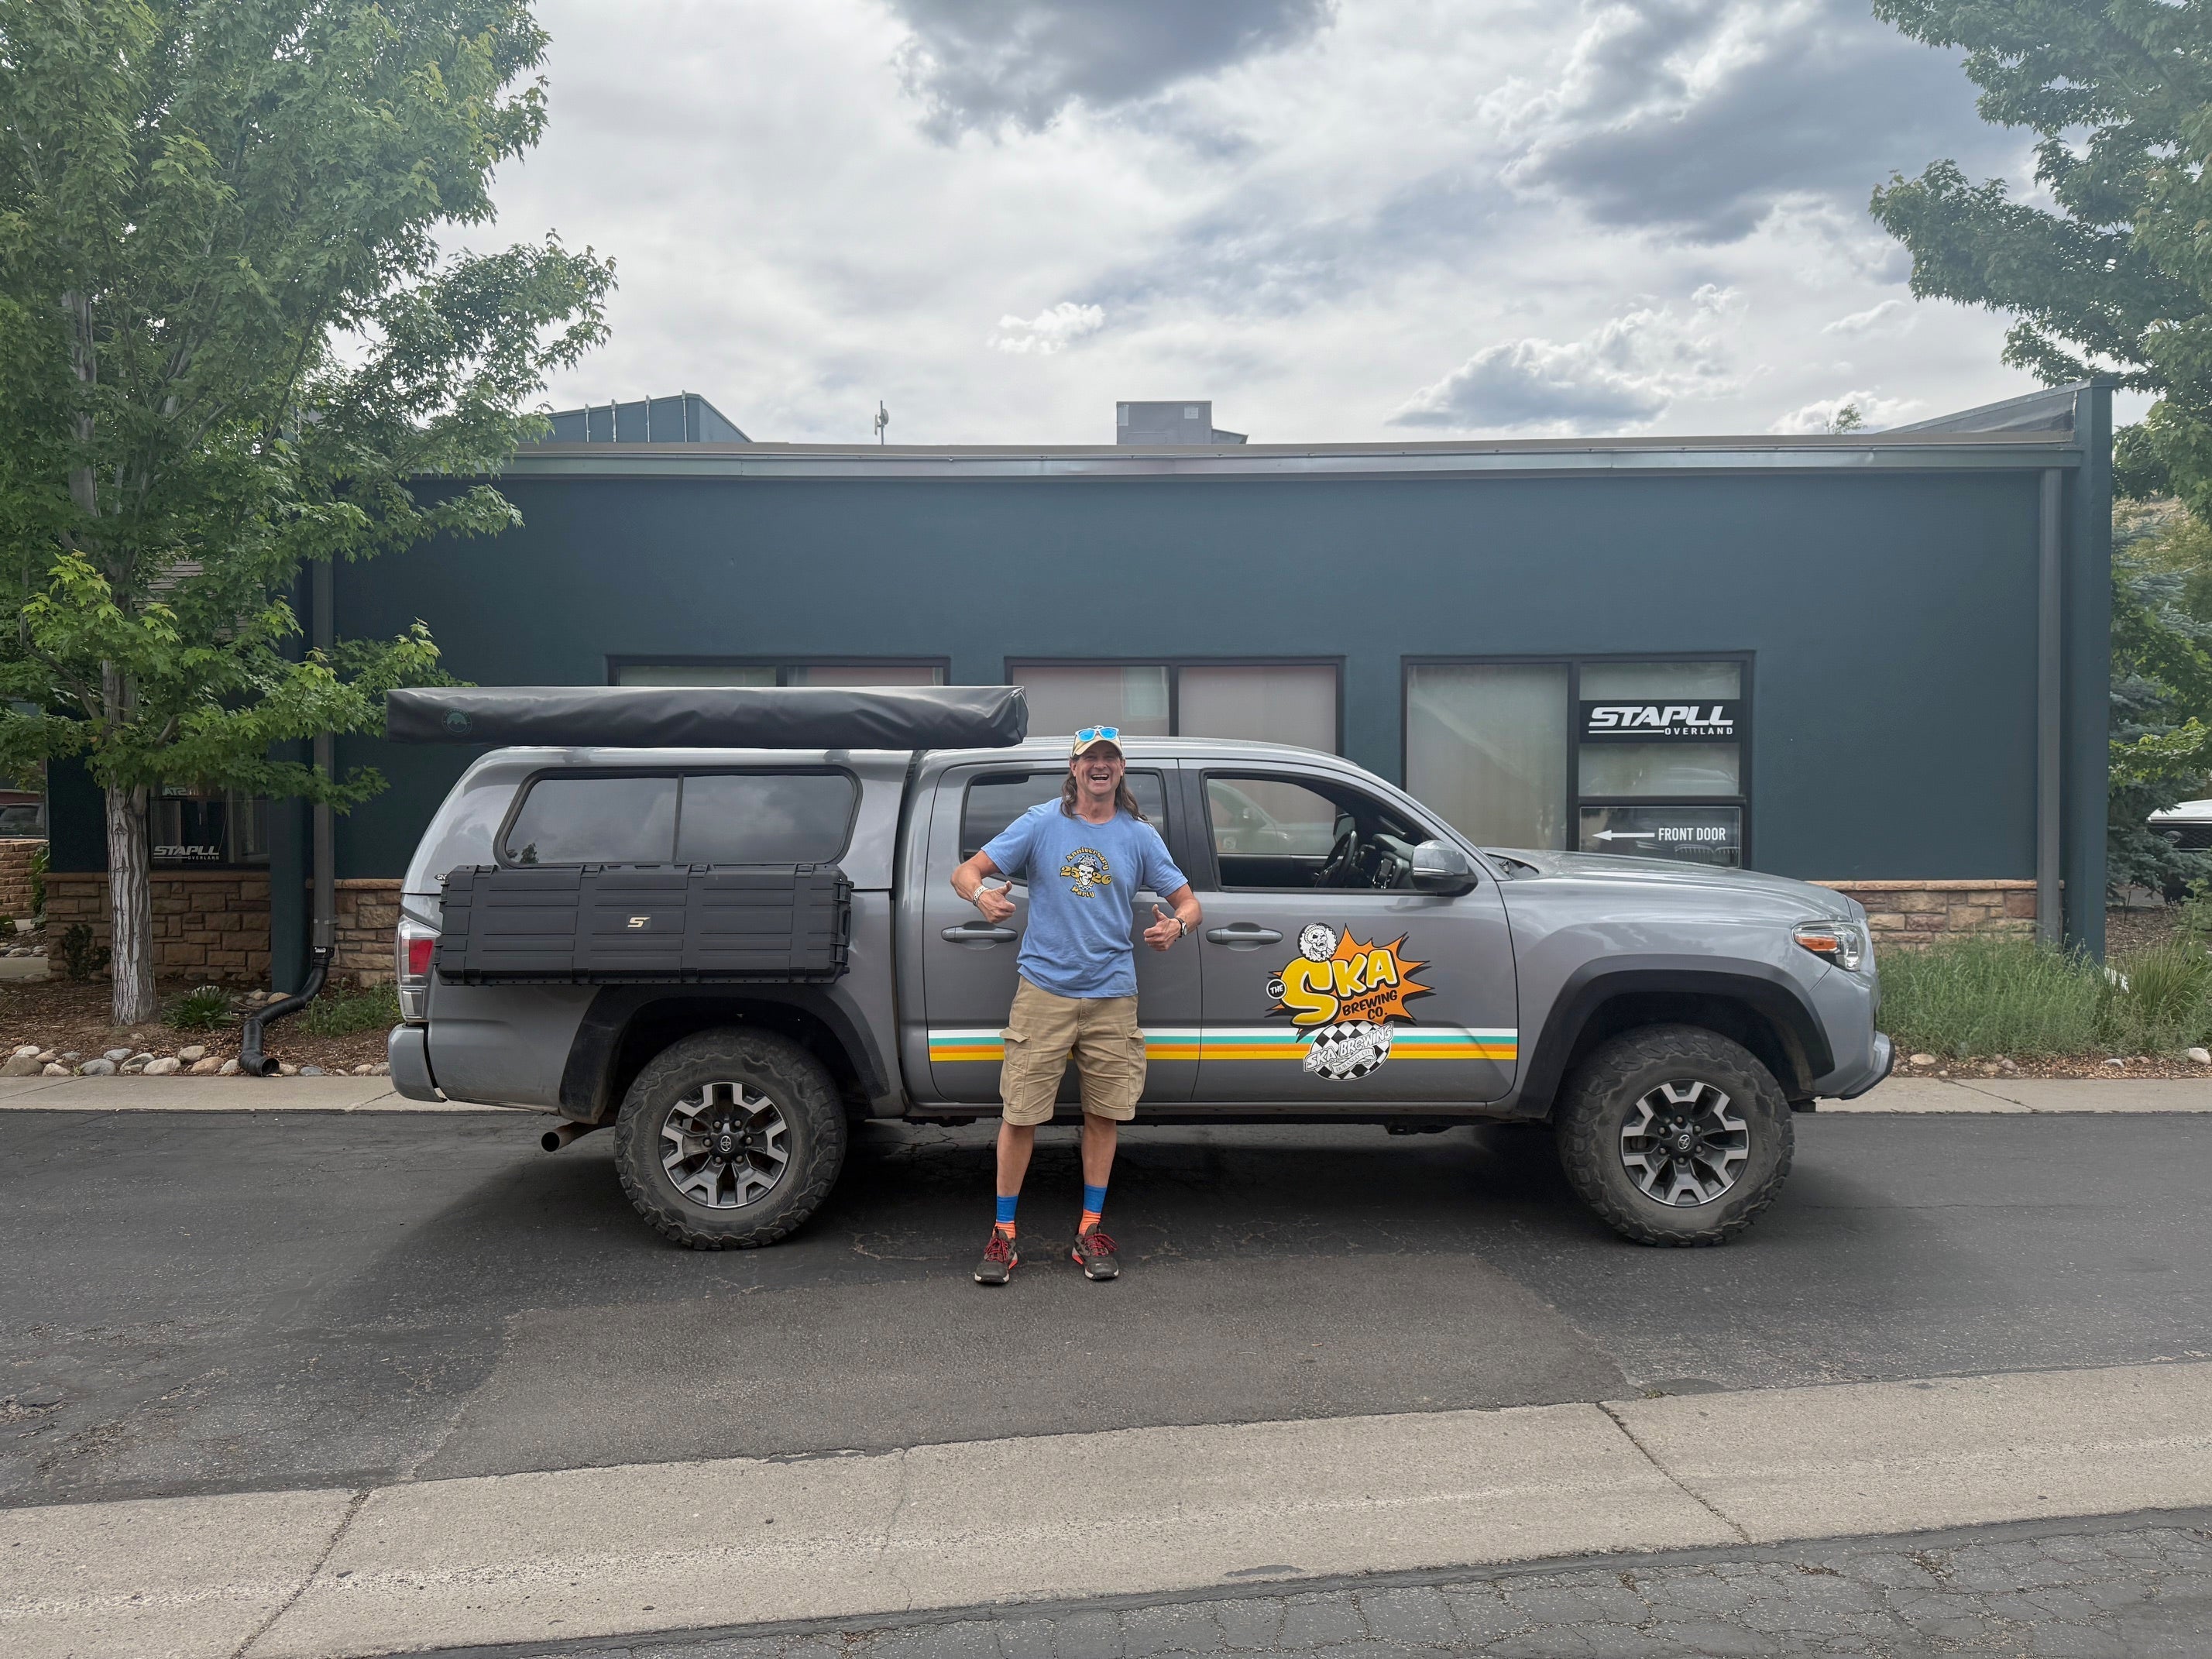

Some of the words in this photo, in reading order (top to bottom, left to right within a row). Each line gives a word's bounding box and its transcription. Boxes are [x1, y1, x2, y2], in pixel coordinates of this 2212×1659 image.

[1589, 706, 1733, 726] STAPLL
[1658, 828, 1693, 841] FRONT
[1696, 827, 1726, 840] DOOR
[153, 846, 220, 856] STAPLL
[1070, 885, 1095, 898] Party
[1269, 984, 1283, 994] THE
[1279, 948, 1400, 1028] SKA
[1342, 990, 1398, 1016] BREWING
[1367, 1007, 1388, 1020] CO.
[1305, 1048, 1338, 1070] SKA
